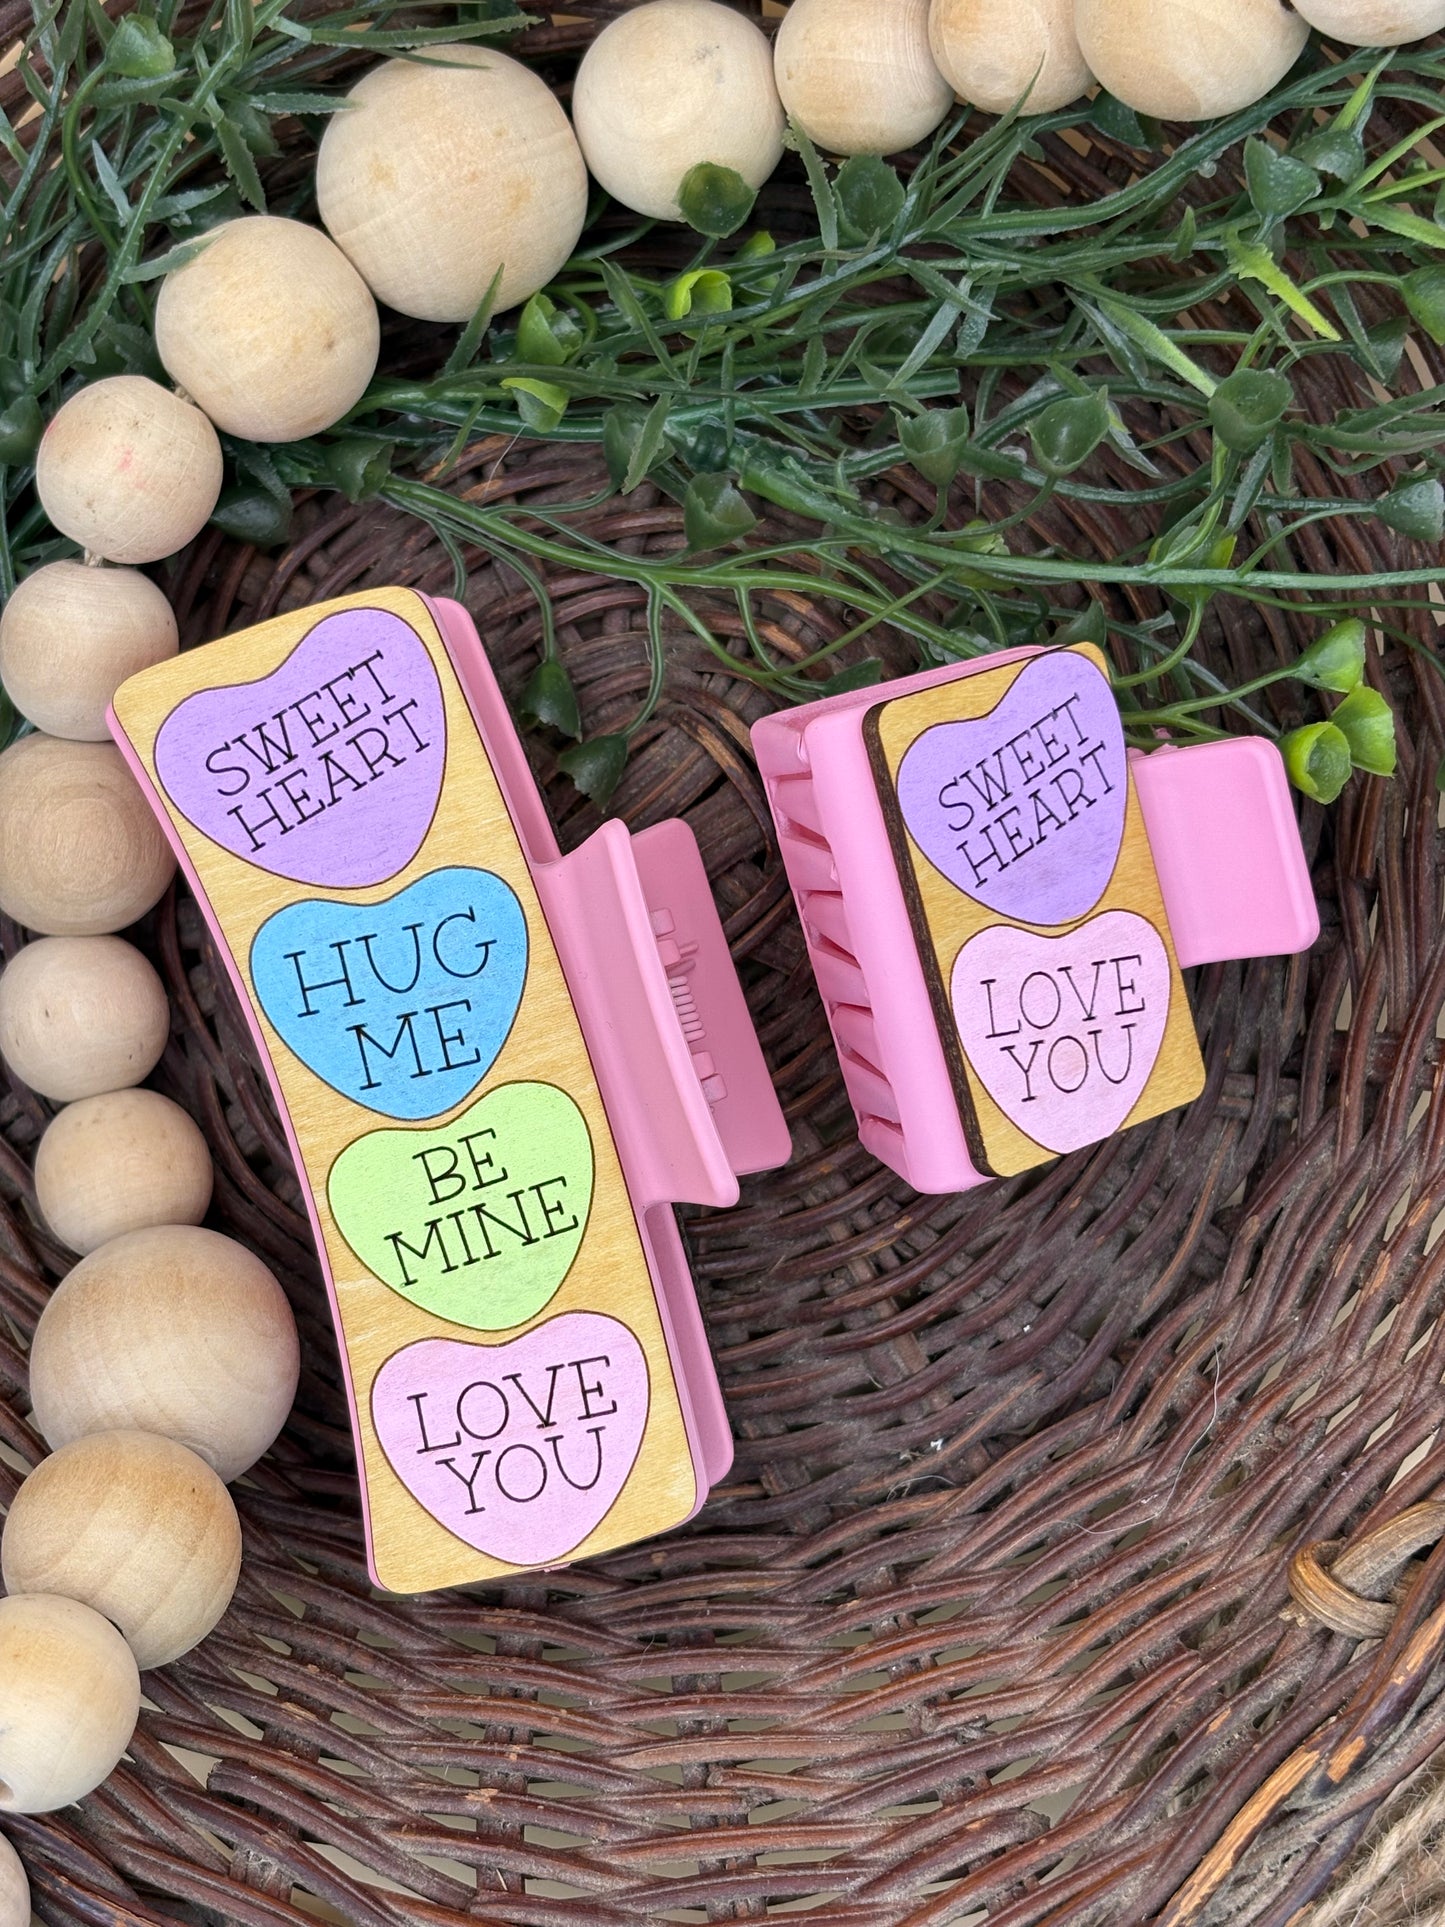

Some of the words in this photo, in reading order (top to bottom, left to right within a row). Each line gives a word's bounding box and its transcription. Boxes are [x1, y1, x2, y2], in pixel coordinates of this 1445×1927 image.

[205, 650, 397, 796] SWEET
[938, 693, 1093, 832] SWEET
[227, 700, 430, 852] HEART
[956, 741, 1116, 889] HEART
[283, 906, 498, 1018] HUG
[979, 955, 1145, 1039] LOVE
[346, 999, 482, 1091] ME
[1000, 1023, 1137, 1102] YOU
[412, 1128, 508, 1206] BE
[384, 1176, 579, 1287] MINE
[407, 1355, 618, 1454] LOVE
[435, 1426, 607, 1514] YOU
